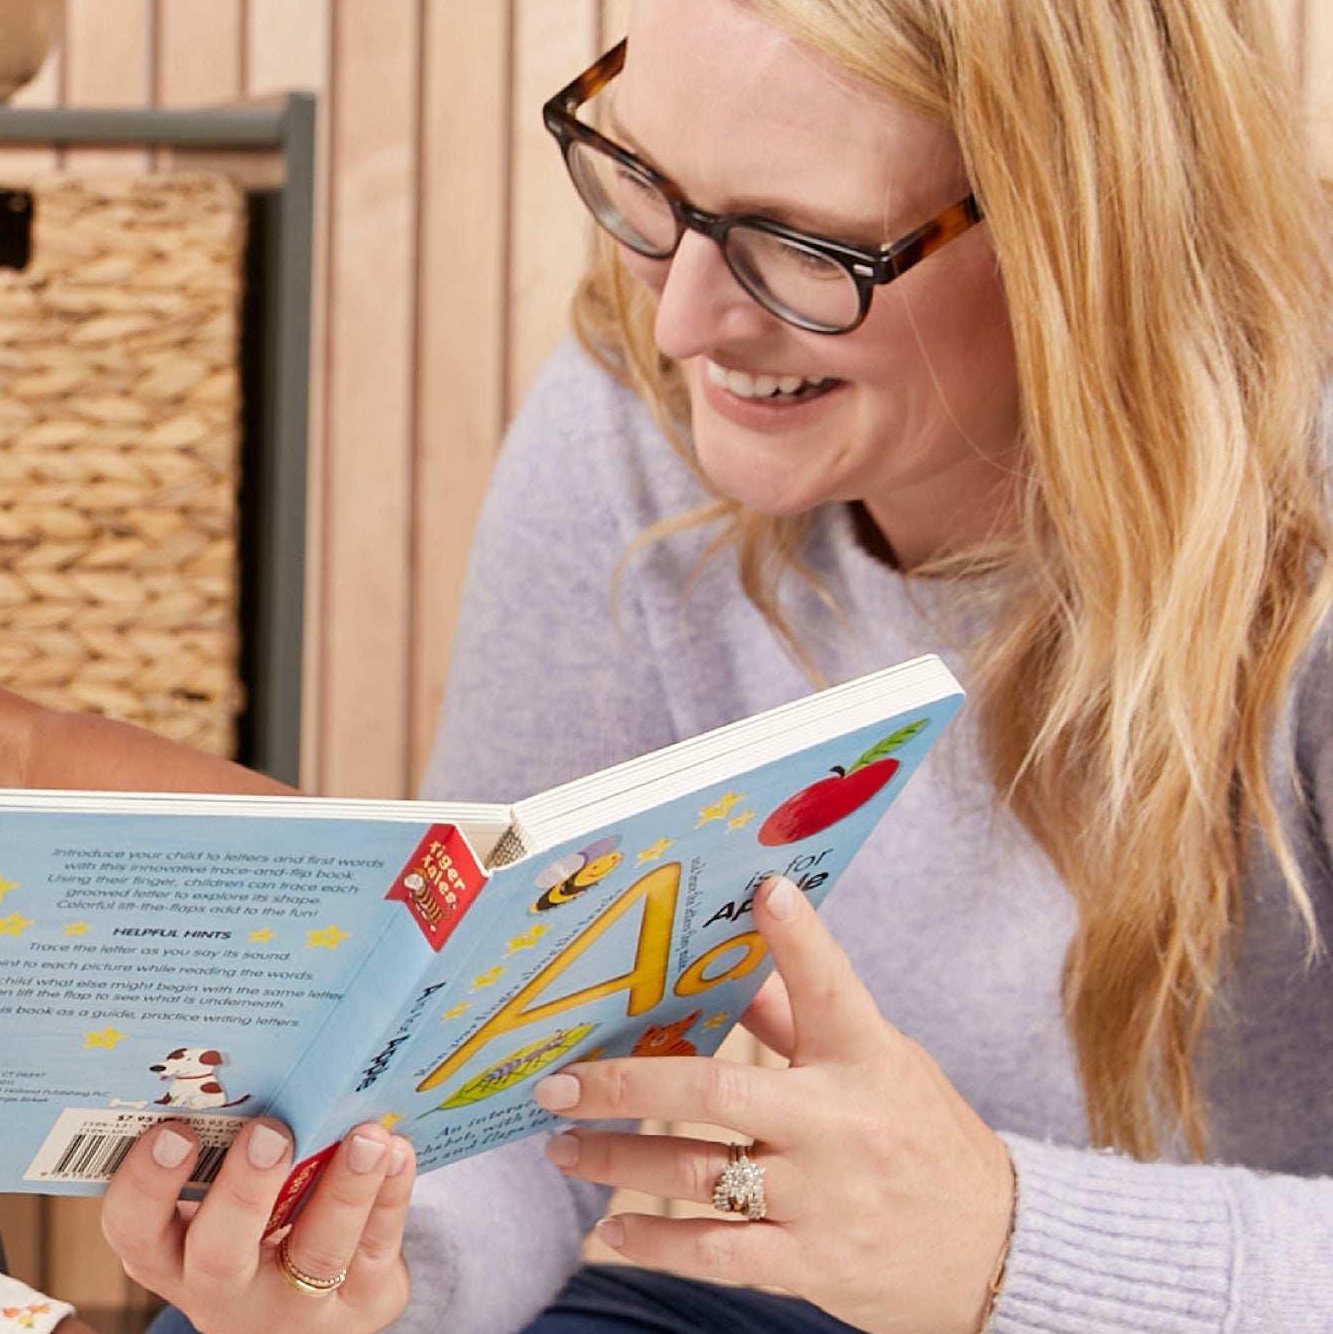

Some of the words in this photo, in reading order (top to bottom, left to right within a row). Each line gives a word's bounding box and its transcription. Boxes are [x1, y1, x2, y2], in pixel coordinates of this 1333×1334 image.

[53, 848, 125, 858] Introduce
[128, 851, 162, 861] your
[166, 851, 202, 860] child
[206, 853, 220, 861] to
[224, 853, 269, 863] letters
[273, 855, 303, 865] and
[307, 855, 335, 865] first
[338, 858, 384, 868] words
[429, 840, 466, 890] tiger
[64, 862, 96, 870] with
[100, 863, 126, 871] this
[130, 864, 207, 874] innovative
[210, 866, 312, 879] trace-and-flip
[744, 869, 775, 891] is
[782, 847, 834, 876] for
[47, 874, 91, 885] Using
[95, 875, 128, 884] their
[183, 878, 244, 888] children
[248, 881, 277, 889] can
[280, 881, 317, 892] trace
[321, 884, 359, 894] each
[65, 888, 130, 898] grooved
[133, 889, 171, 898] letter
[174, 891, 188, 899] to
[192, 892, 249, 902] explore
[251, 893, 269, 902] its
[701, 871, 830, 929] Aple
[56, 899, 115, 910] Colorful
[118, 902, 206, 914] lift-the-flaps
[209, 905, 240, 914] add
[243, 907, 258, 915] to
[261, 907, 285, 915] the
[113, 927, 179, 938] HELPFUL
[183, 930, 232, 940] HINTS
[30, 943, 70, 952] Trace
[73, 943, 96, 953] the
[100, 944, 136, 954] letter
[140, 947, 158, 955] as
[162, 948, 190, 958] you
[194, 949, 221, 958] say
[222, 949, 238, 959] its
[22, 959, 37, 967] to
[41, 960, 78, 969] each
[81, 962, 132, 972] picture
[136, 964, 175, 973] while
[179, 966, 237, 978] reading
[240, 967, 263, 977] the
[414, 860, 769, 1093] Aa
[16, 988, 33, 997] lift
[36, 989, 60, 998] the
[63, 990, 91, 1001] flap
[95, 991, 109, 1000] to
[143, 994, 180, 1004] what
[184, 995, 195, 1004] is
[36, 977, 74, 987] what
[76, 979, 107, 988] else
[110, 981, 153, 992] might
[156, 982, 198, 993] begin
[202, 984, 232, 994] with
[236, 985, 259, 996] the
[262, 988, 305, 998] same
[16, 1005, 52, 1015] book
[56, 1008, 74, 1016] as
[78, 1009, 89, 1017] a
[140, 1011, 200, 1022] practice
[203, 1014, 253, 1026] writing
[355, 1034, 411, 1093] Apple
